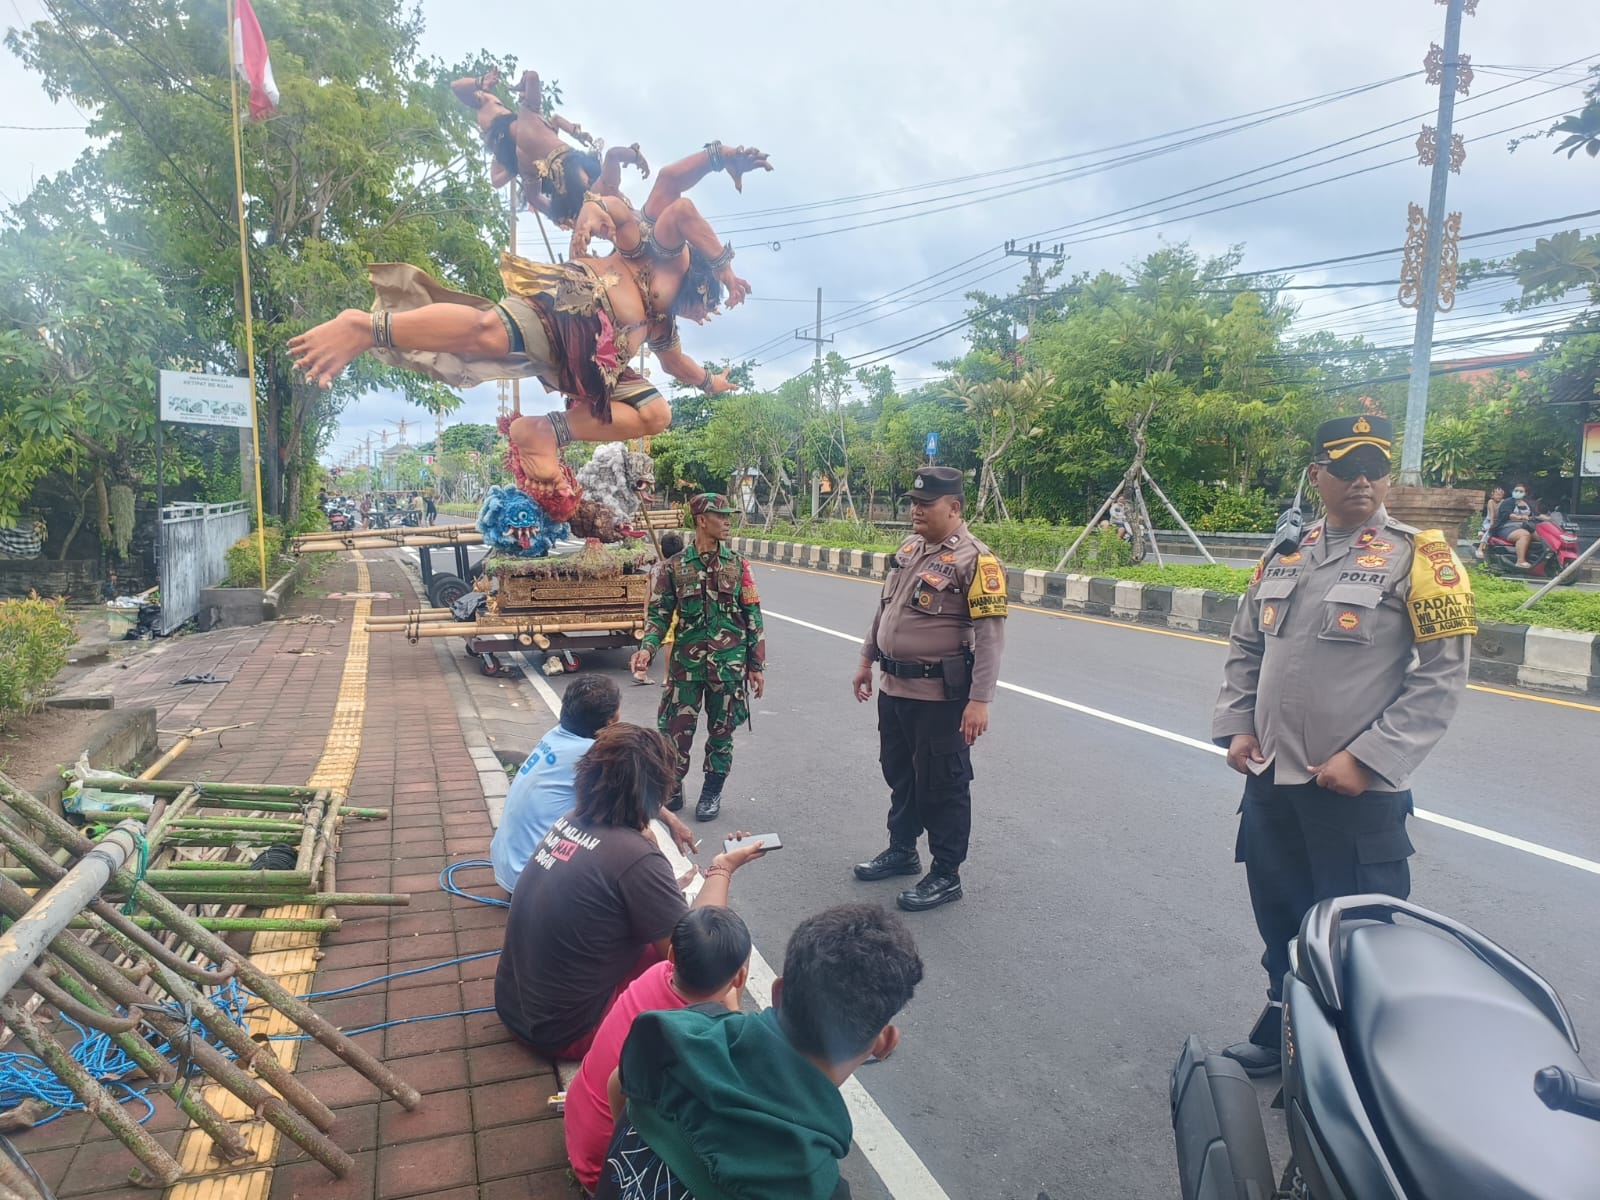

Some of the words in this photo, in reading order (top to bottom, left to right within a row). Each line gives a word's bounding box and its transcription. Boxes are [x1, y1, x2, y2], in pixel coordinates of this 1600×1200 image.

[929, 562, 953, 577] POLRI
[1266, 568, 1285, 577] TRI
[1340, 572, 1386, 583] POLRI
[1413, 595, 1462, 613] PADAL
[1417, 605, 1463, 624] WILAYAH
[1440, 618, 1467, 631] AGUNG
